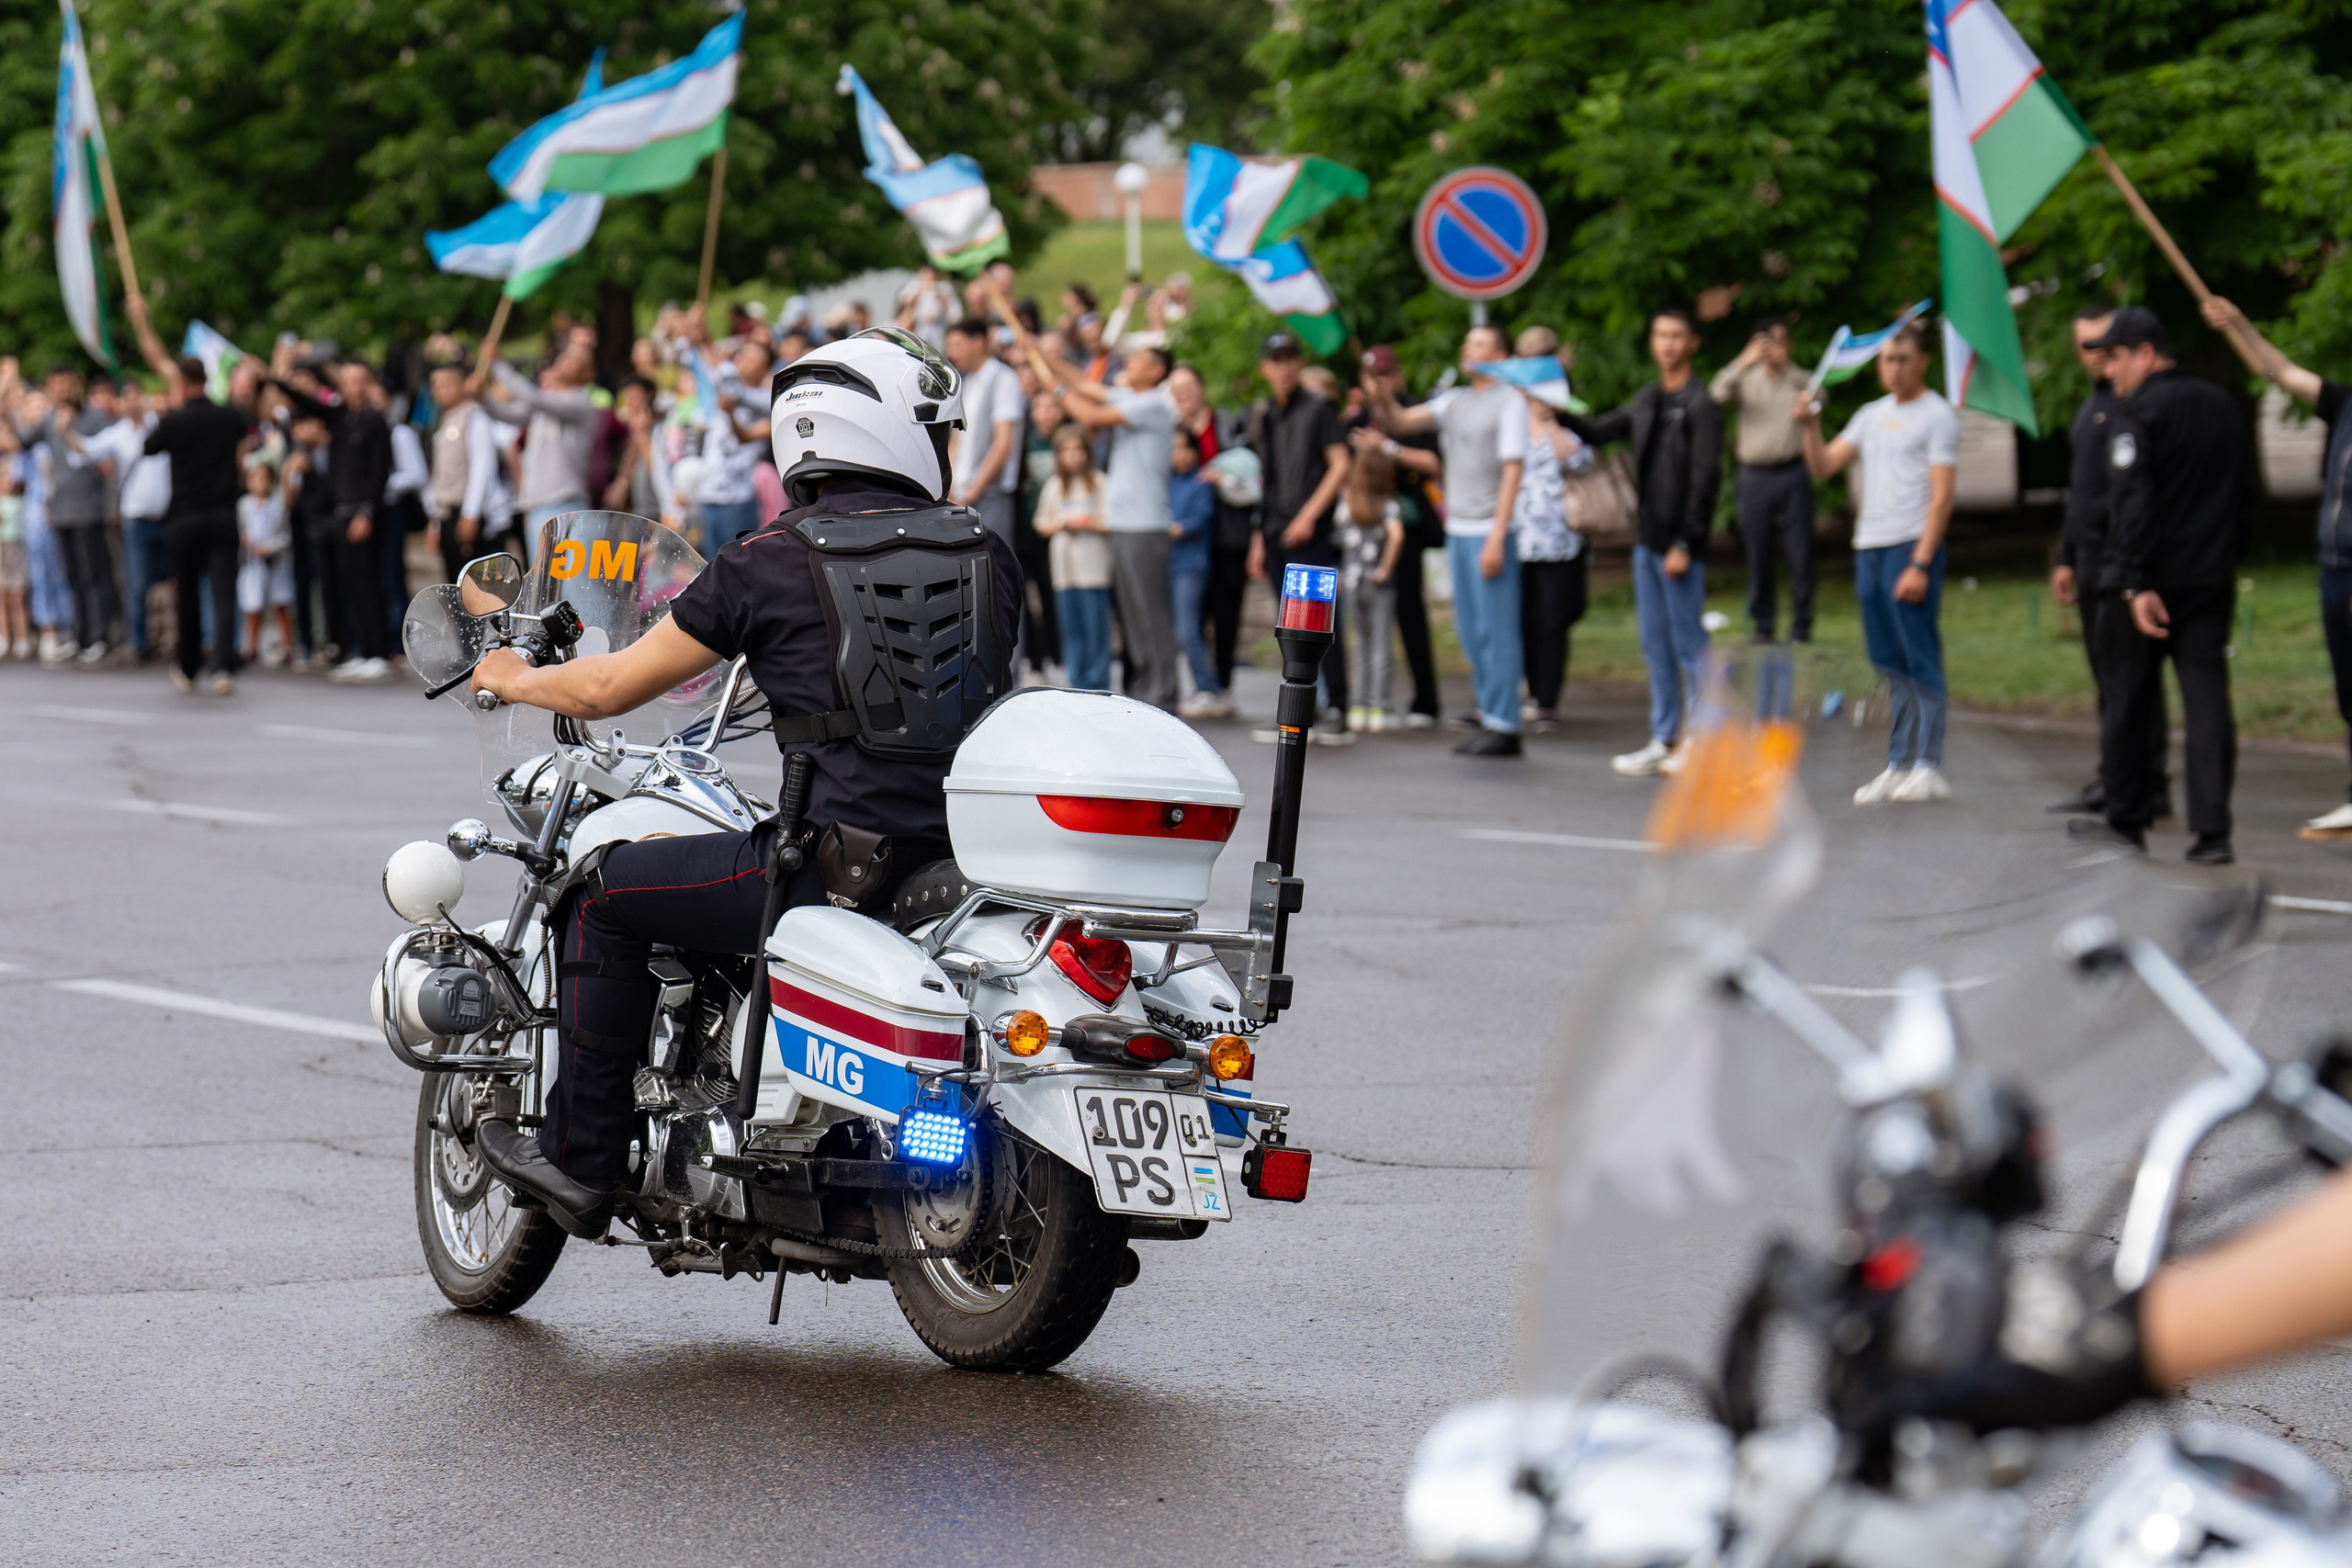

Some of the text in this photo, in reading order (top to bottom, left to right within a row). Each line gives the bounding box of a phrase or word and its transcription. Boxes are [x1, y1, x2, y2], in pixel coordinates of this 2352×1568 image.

[806, 1035, 865, 1095] MG
[1086, 1097, 1169, 1149] 109
[1106, 1154, 1175, 1205] PS
